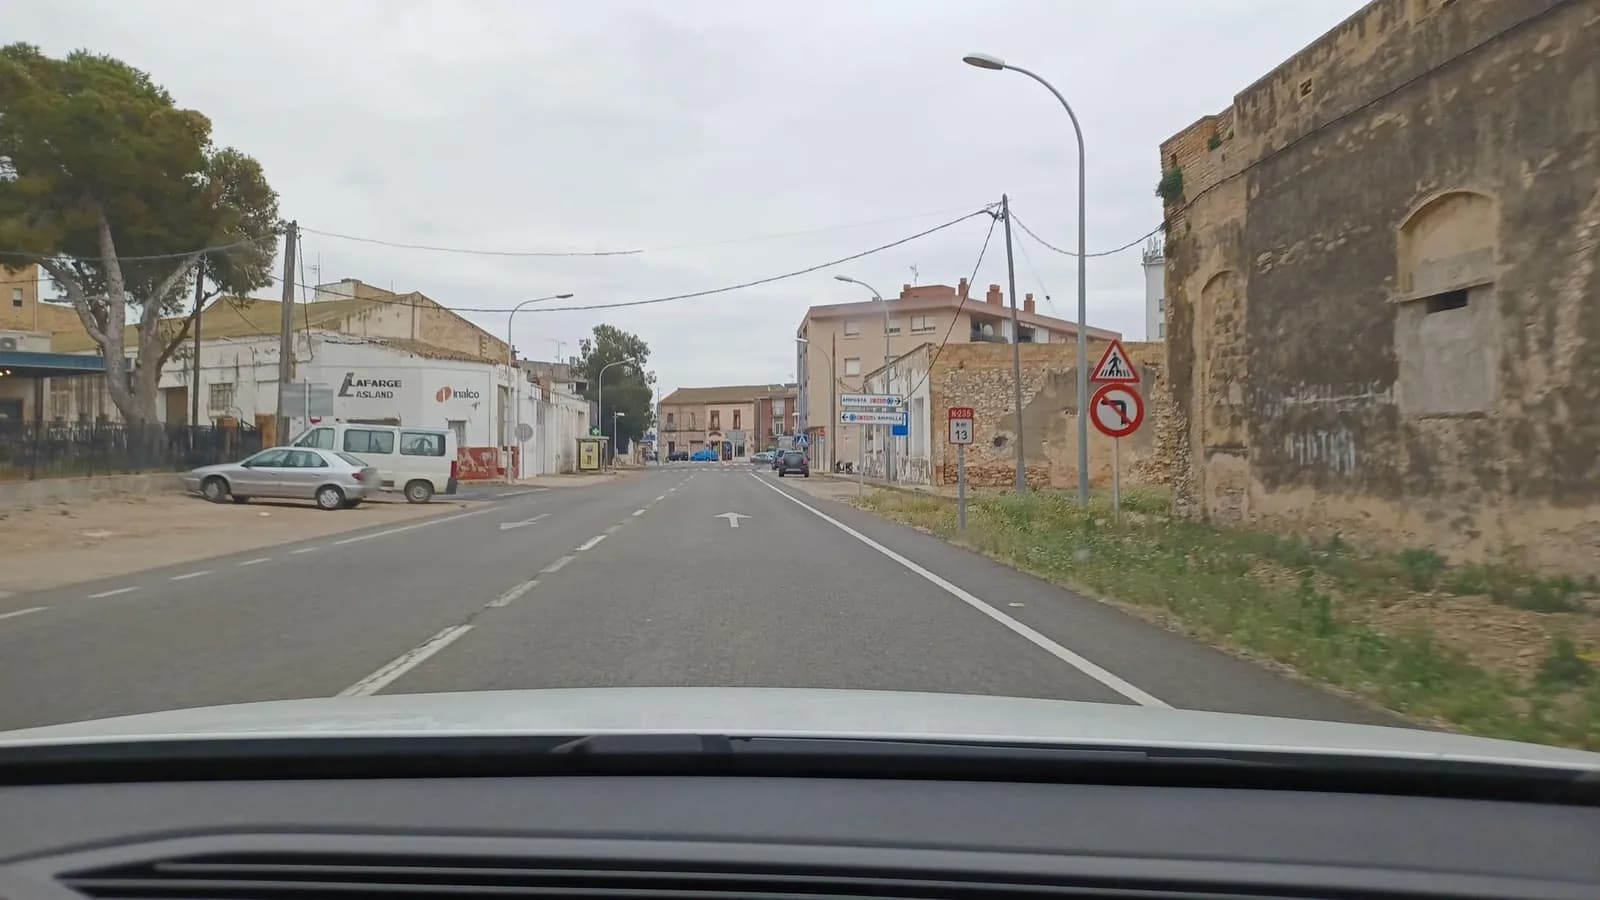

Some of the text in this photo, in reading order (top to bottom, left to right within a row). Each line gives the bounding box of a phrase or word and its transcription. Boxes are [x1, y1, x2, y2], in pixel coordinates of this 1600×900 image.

[338, 372, 402, 397] LAFARGE
[356, 390, 394, 399] ASLAND
[453, 388, 480, 399] inalco
[955, 430, 968, 440] 13
